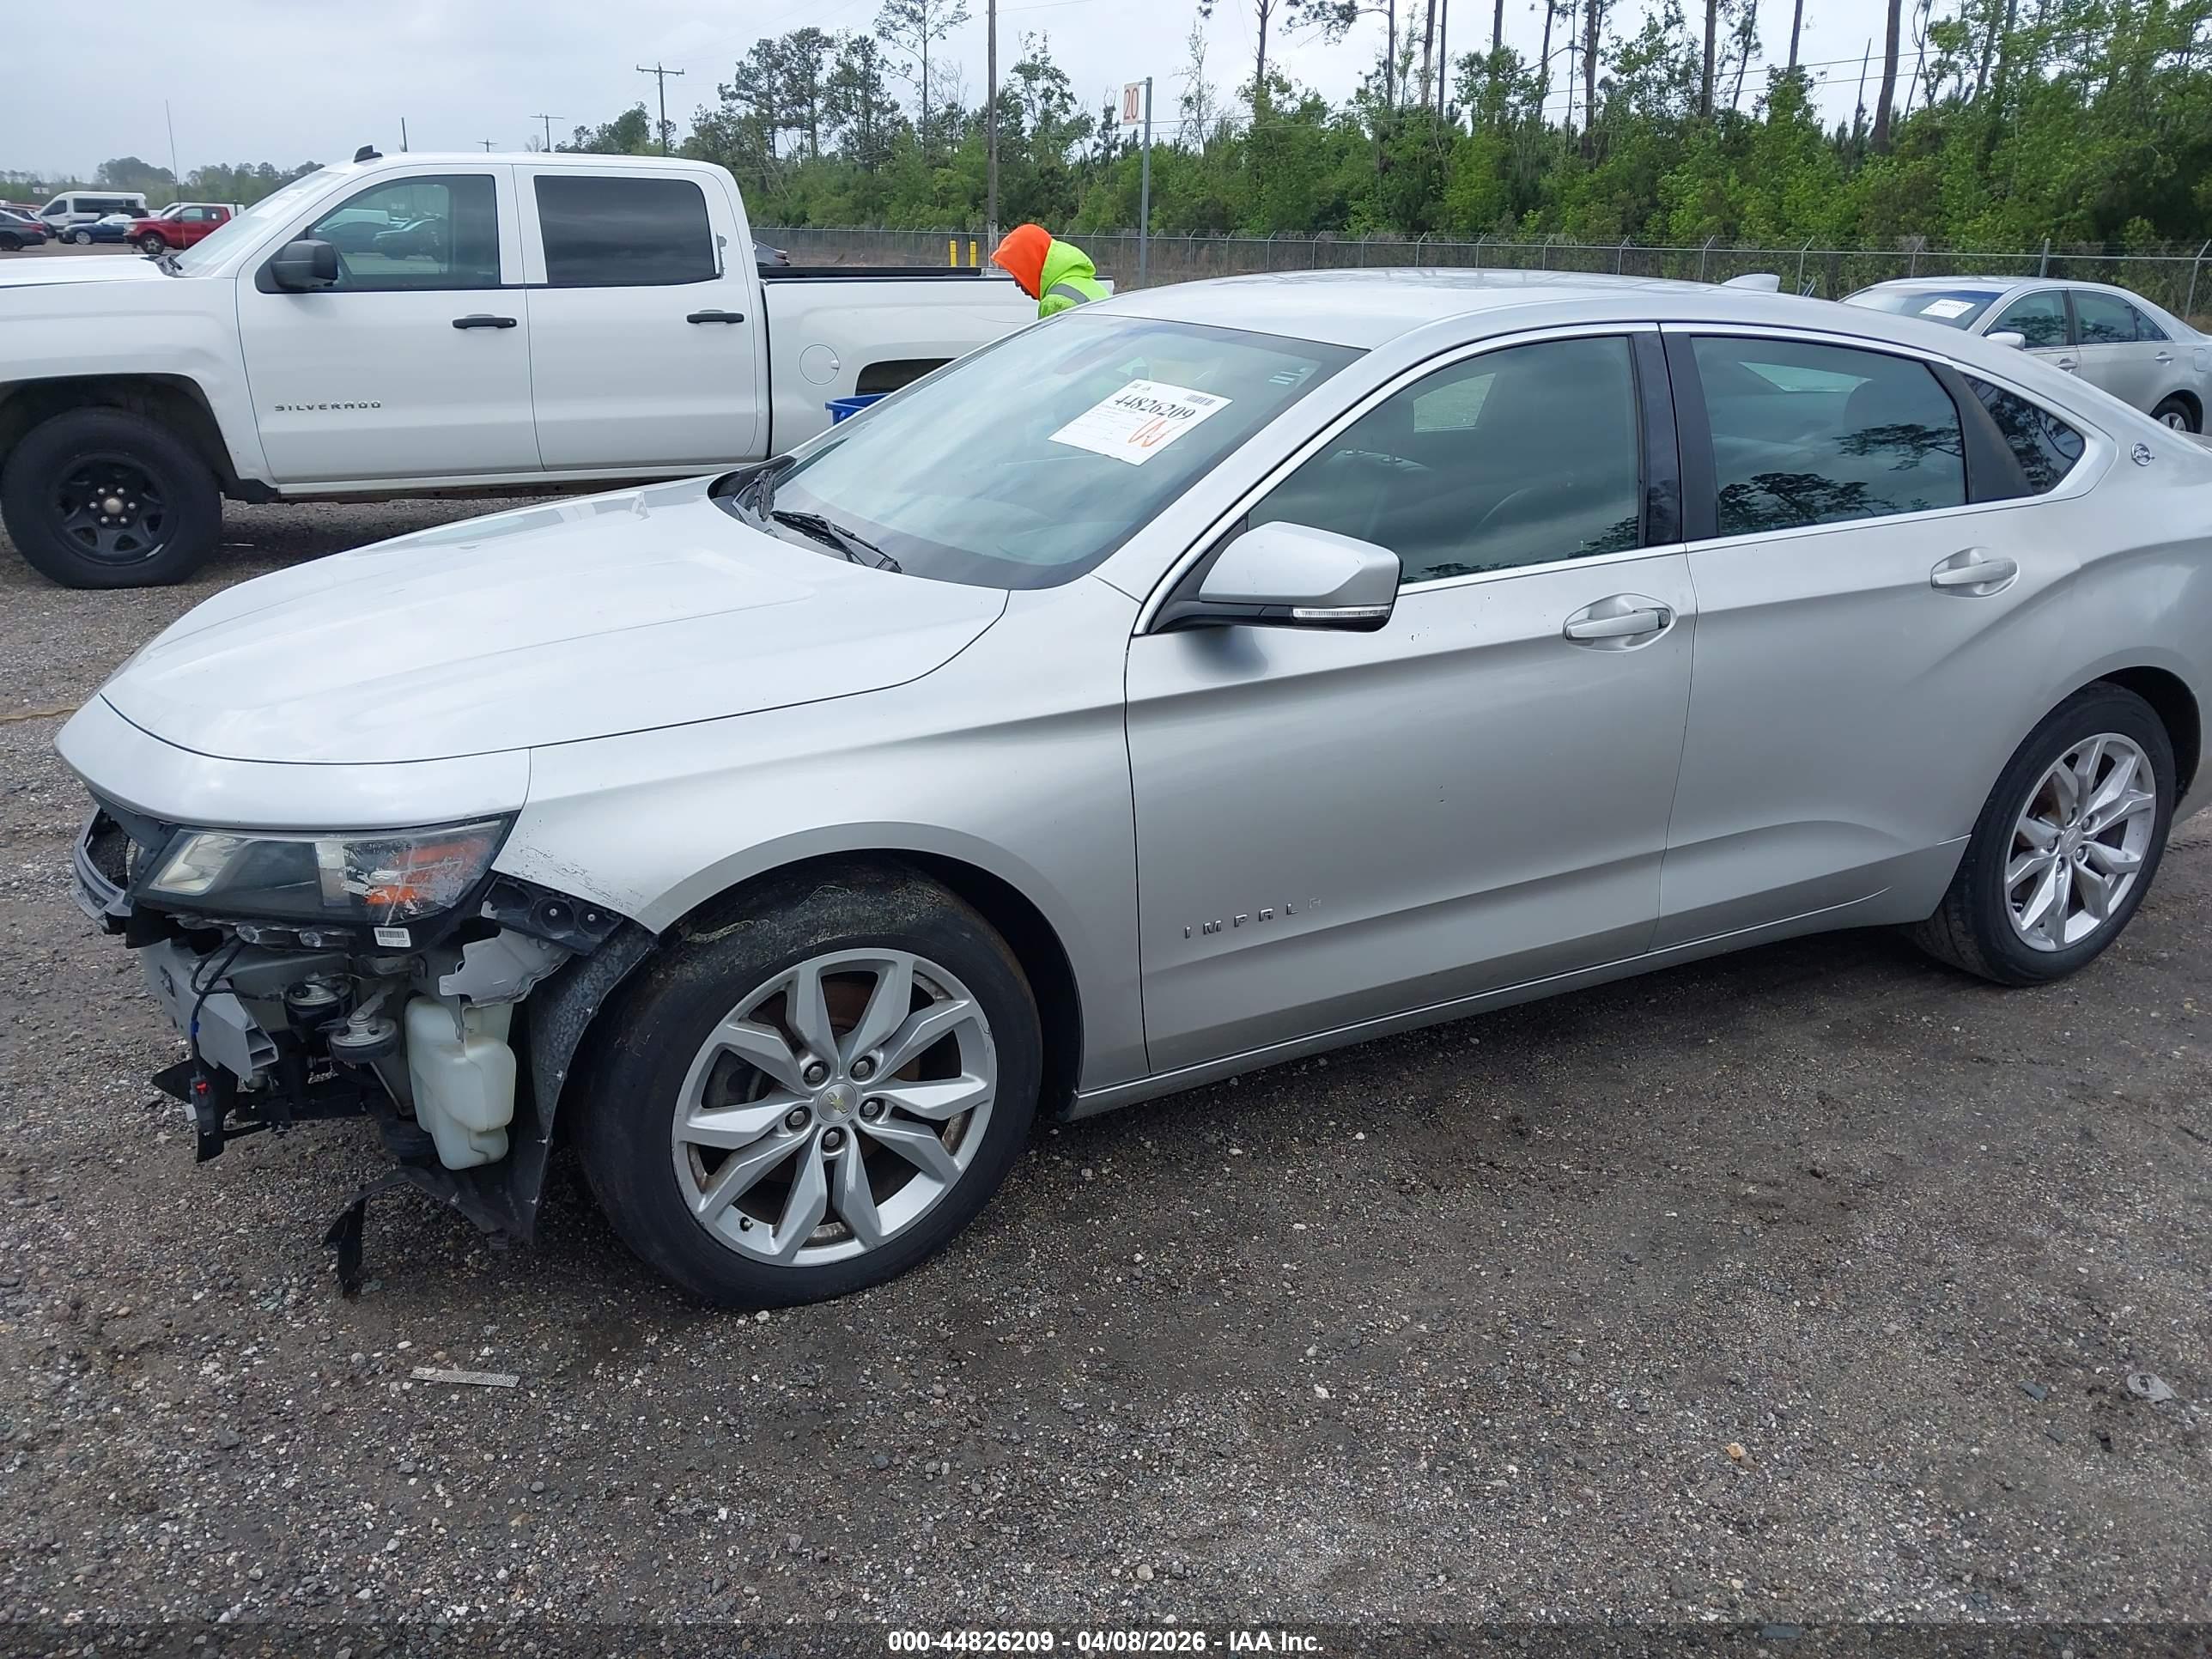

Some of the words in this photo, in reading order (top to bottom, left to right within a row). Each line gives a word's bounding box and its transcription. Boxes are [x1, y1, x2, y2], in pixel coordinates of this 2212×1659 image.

[1123, 87, 1139, 120] 20
[275, 400, 382, 411] SILVERADO
[1115, 394, 1196, 420] 44826209
